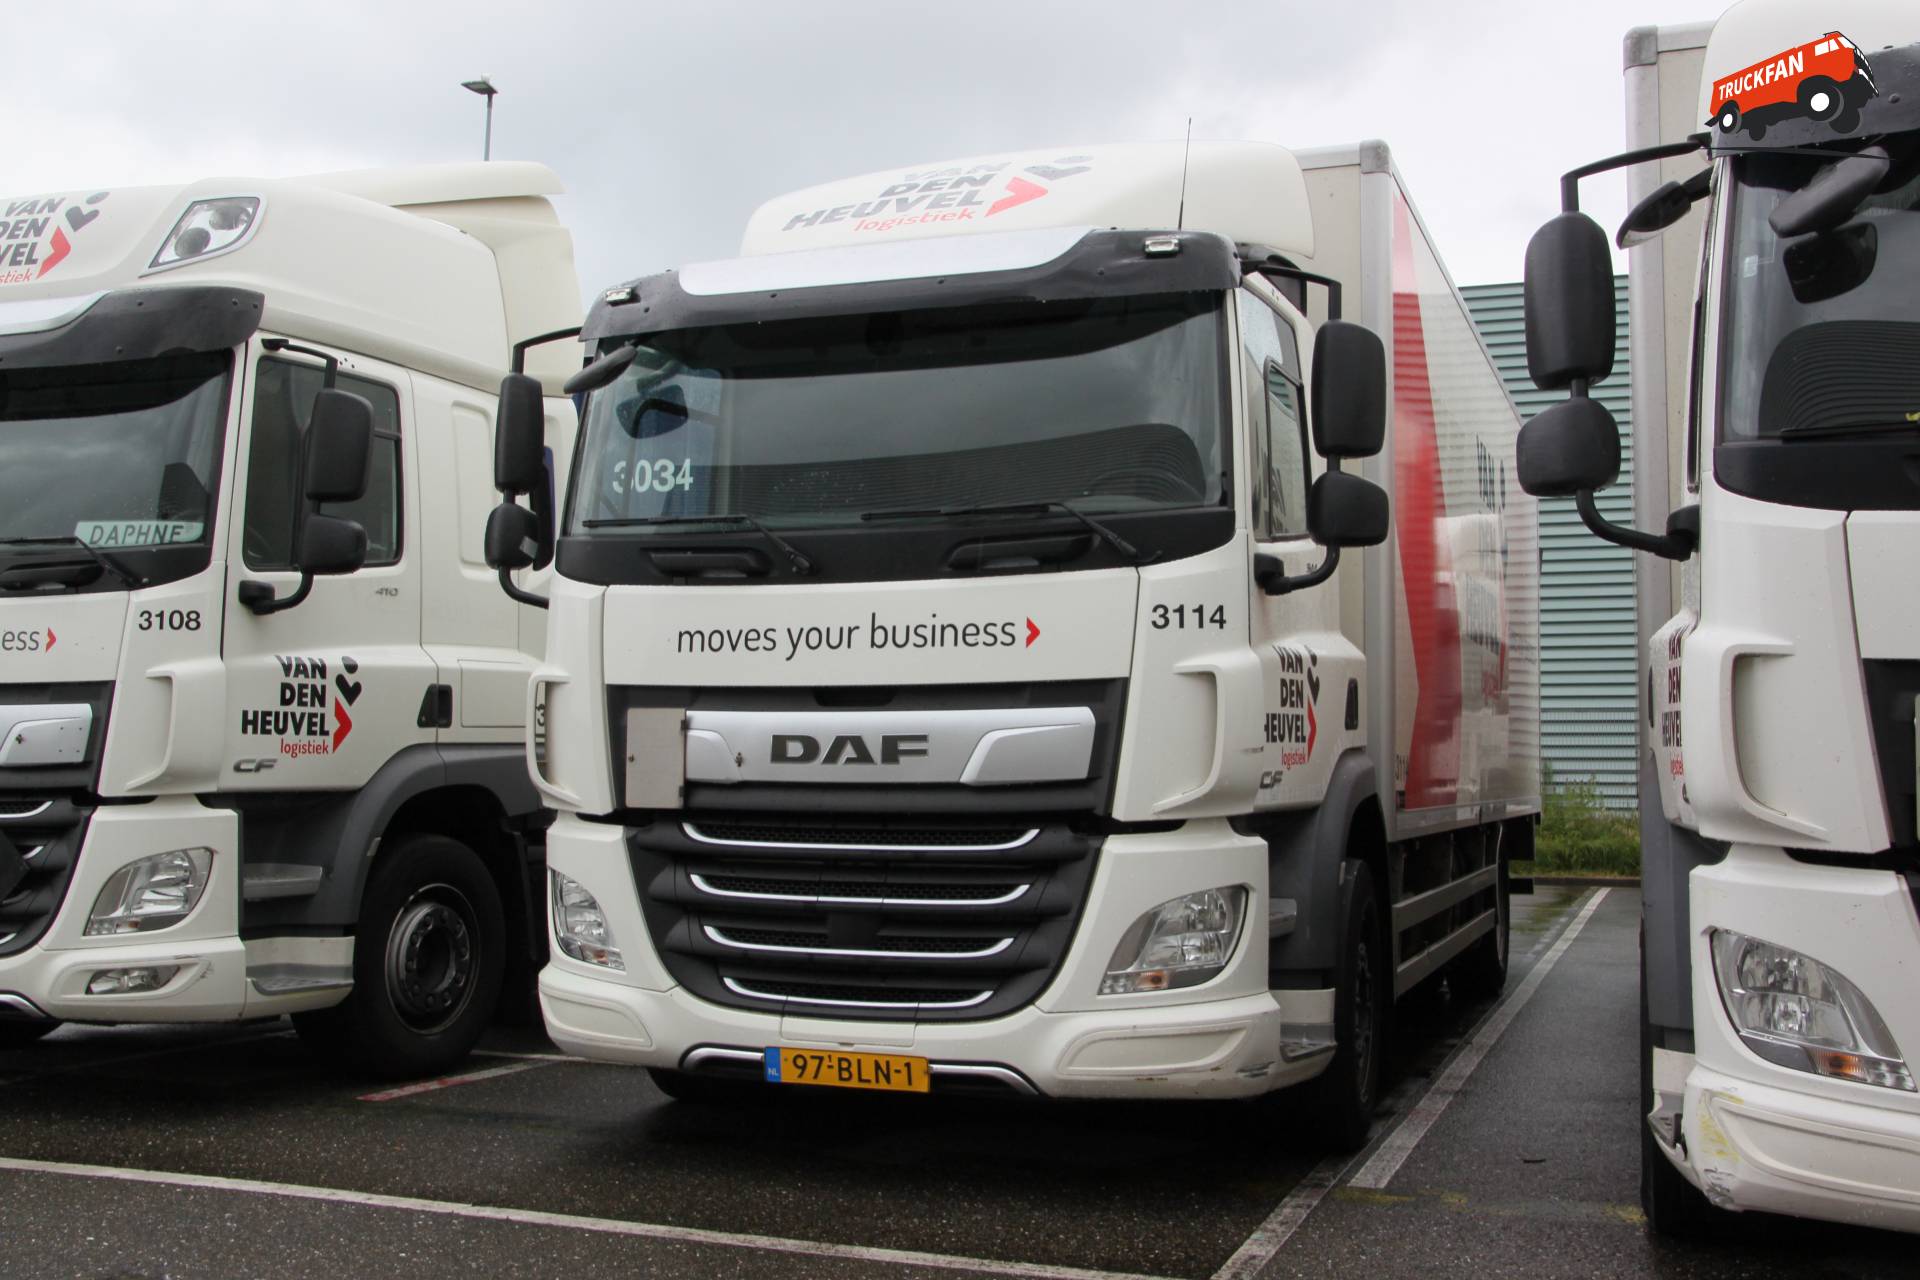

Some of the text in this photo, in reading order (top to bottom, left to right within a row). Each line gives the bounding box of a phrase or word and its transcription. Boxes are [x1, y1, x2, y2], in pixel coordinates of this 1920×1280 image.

[879, 173, 996, 198] DEN
[5, 197, 65, 217] VAN
[781, 188, 984, 231] HEUVEL
[853, 208, 977, 232] logistiek
[612, 458, 694, 494] 3034
[138, 610, 201, 631] 3108
[1151, 604, 1227, 629] 3114
[676, 611, 1016, 662] moves your business
[274, 655, 327, 679] VAN
[1272, 645, 1303, 674] VAN
[280, 682, 327, 708] DEN
[1280, 678, 1304, 709] DEN
[241, 709, 330, 737] HEUVEL
[280, 737, 329, 759] logistiek
[770, 734, 929, 766] DAF
[233, 758, 278, 773] CF
[767, 1053, 914, 1087] NL 97-BLN-1
